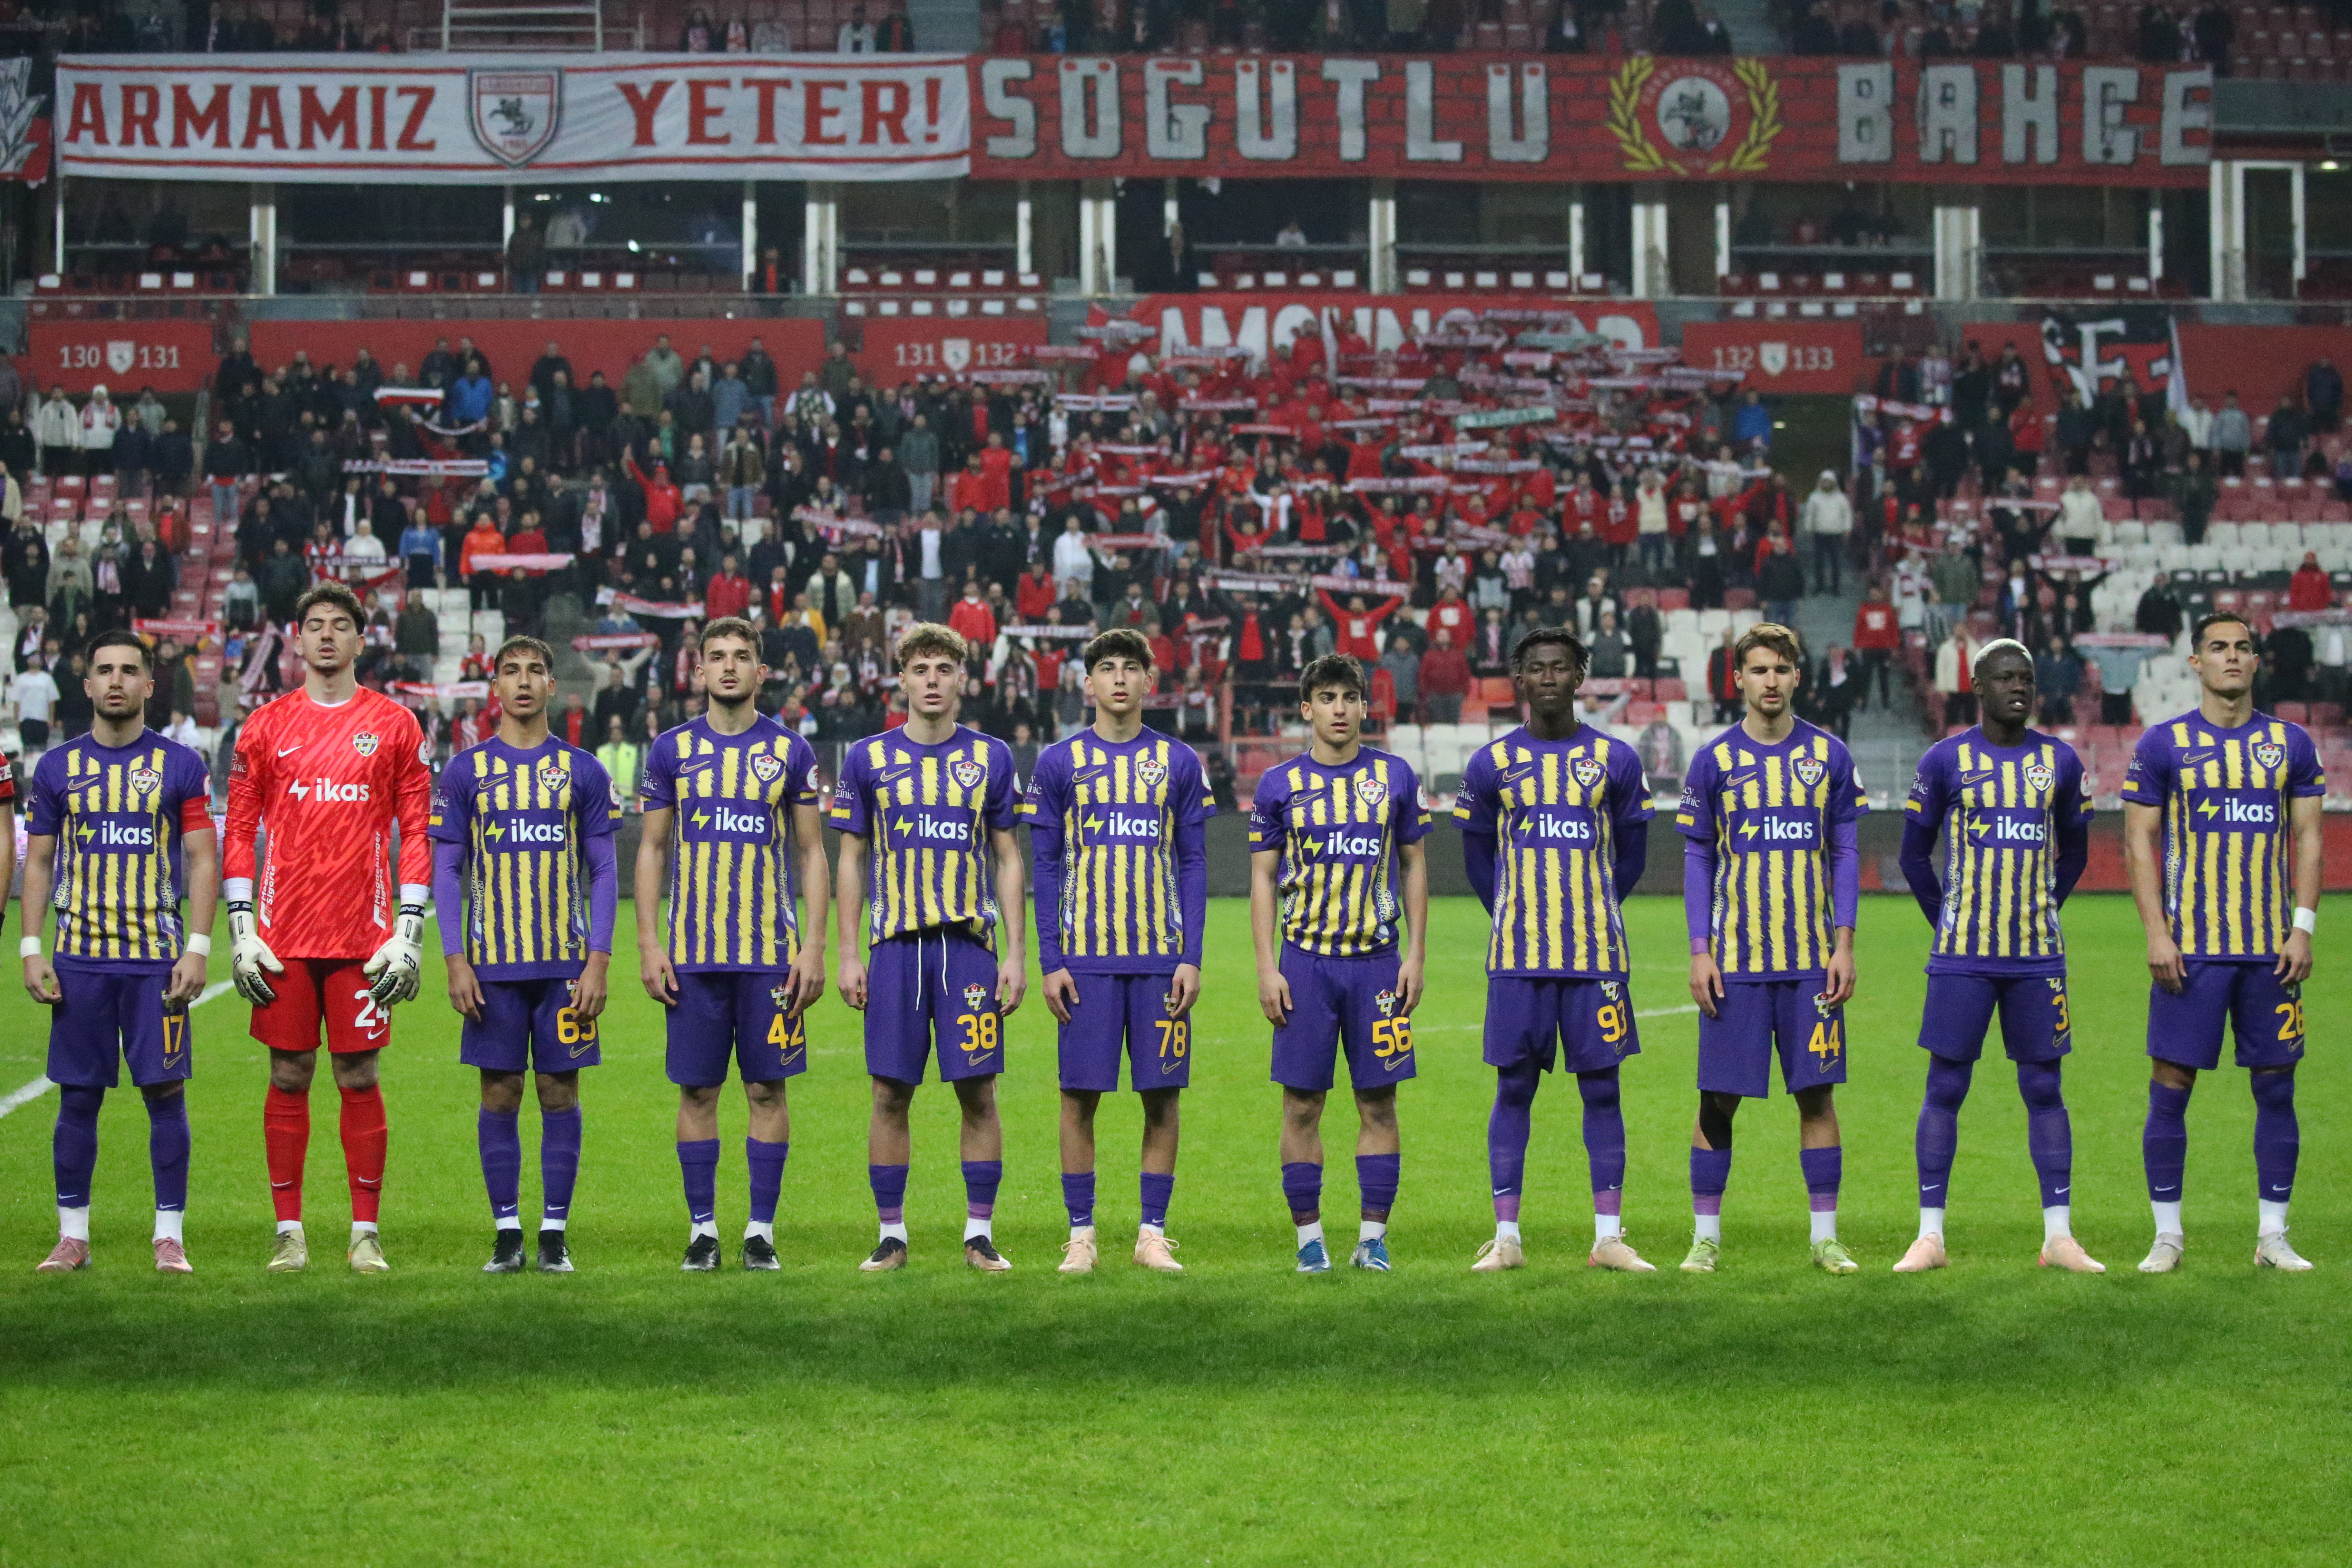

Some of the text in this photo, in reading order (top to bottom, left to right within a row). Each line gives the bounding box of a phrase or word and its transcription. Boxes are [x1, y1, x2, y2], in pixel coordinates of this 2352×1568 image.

[65, 78, 942, 151] ARMAMIZ YETER!
[60, 347, 100, 368] 130
[139, 346, 179, 368] 131
[896, 344, 935, 365] 131
[976, 345, 1016, 365] 132
[1712, 347, 1754, 370] 132
[1793, 348, 1834, 370] 133
[316, 778, 370, 802] ikas
[715, 807, 765, 834] ikas
[2225, 798, 2274, 823] ikas
[102, 821, 153, 845] ikas
[511, 818, 565, 842] ikas
[918, 813, 968, 840] ikas
[1109, 812, 1159, 837] ikas
[1539, 813, 1590, 839] ikas
[1764, 816, 1813, 840] ikas
[1997, 816, 2044, 841] ikas
[1328, 832, 1380, 856] ikas
[354, 990, 390, 1027] 24
[163, 1015, 185, 1053] 17
[767, 1013, 804, 1049] 42
[956, 1012, 997, 1051] 38
[1155, 1020, 1187, 1058] 78
[1372, 1017, 1412, 1057] 56
[1808, 1019, 1840, 1058] 44
